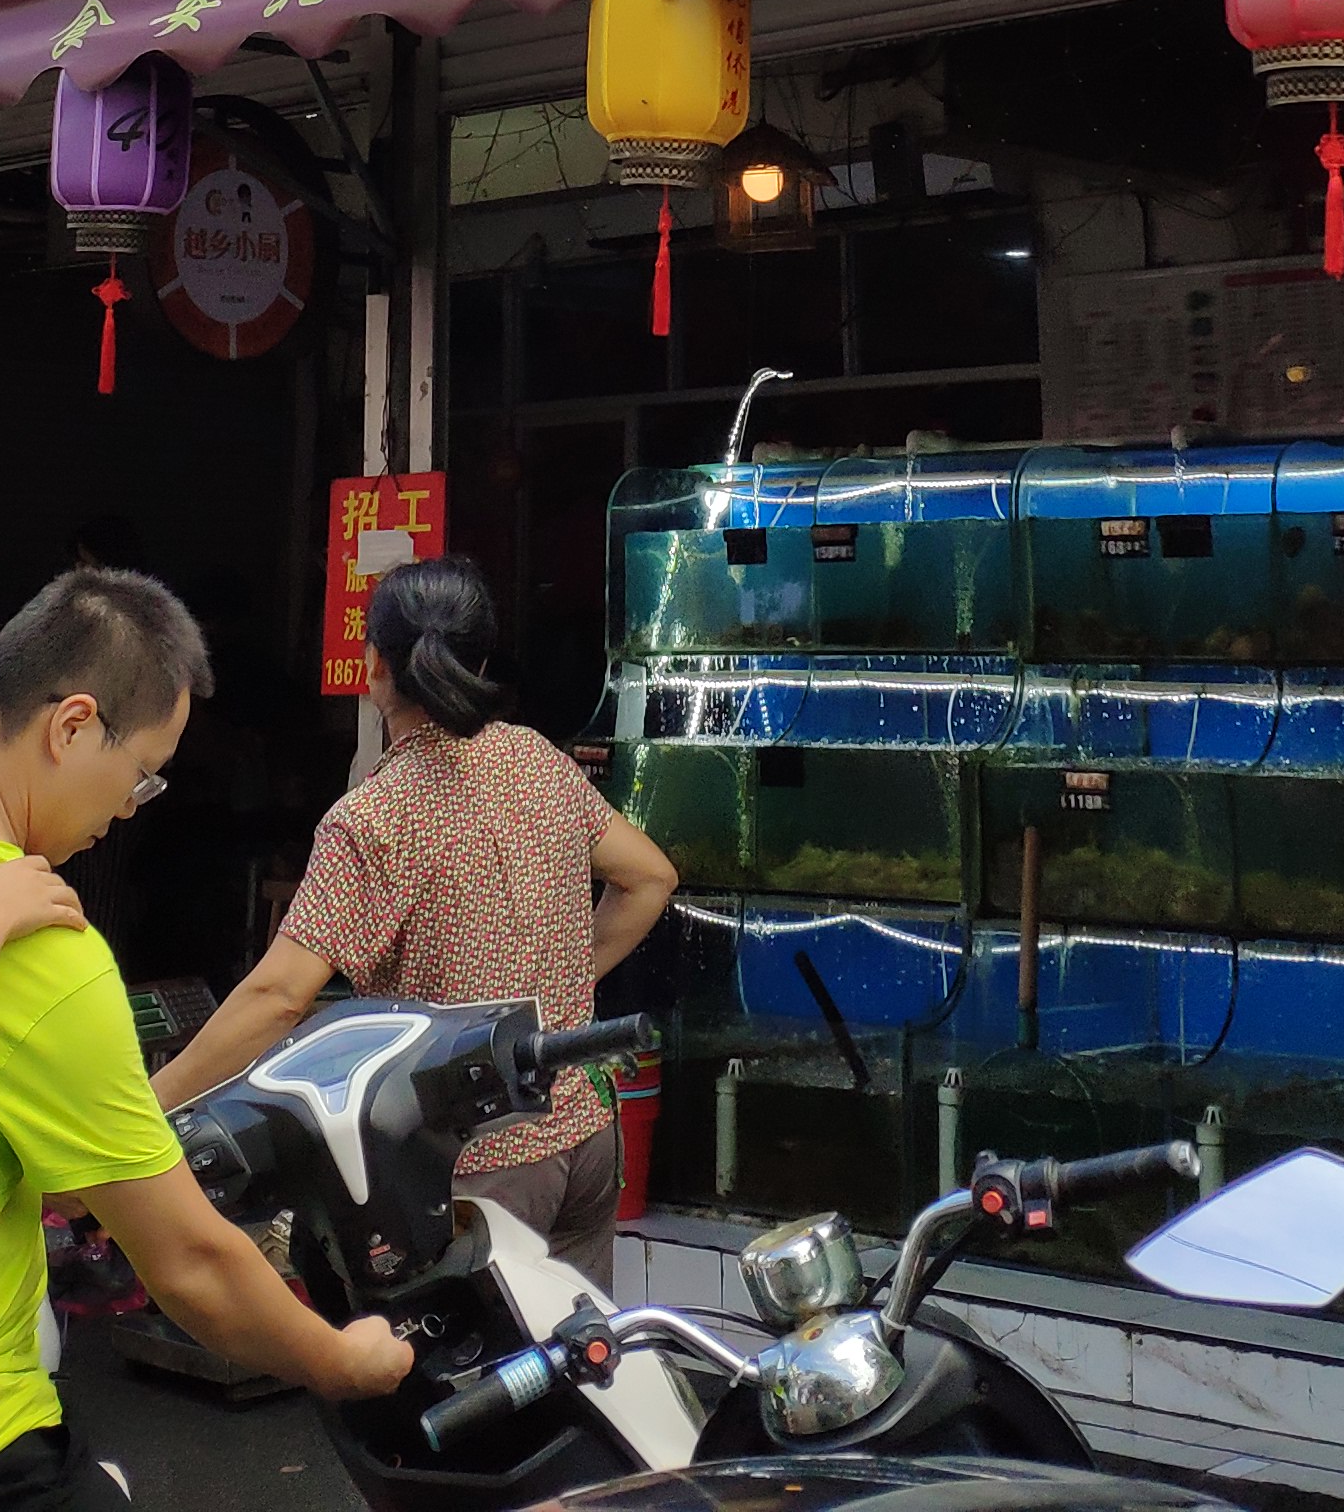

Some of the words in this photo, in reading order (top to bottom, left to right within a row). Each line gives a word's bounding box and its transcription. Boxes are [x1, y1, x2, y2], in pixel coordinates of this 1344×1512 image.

[184, 226, 282, 264] 越乡小厨
[341, 489, 432, 541] 招工
[325, 657, 369, 686] 1867
